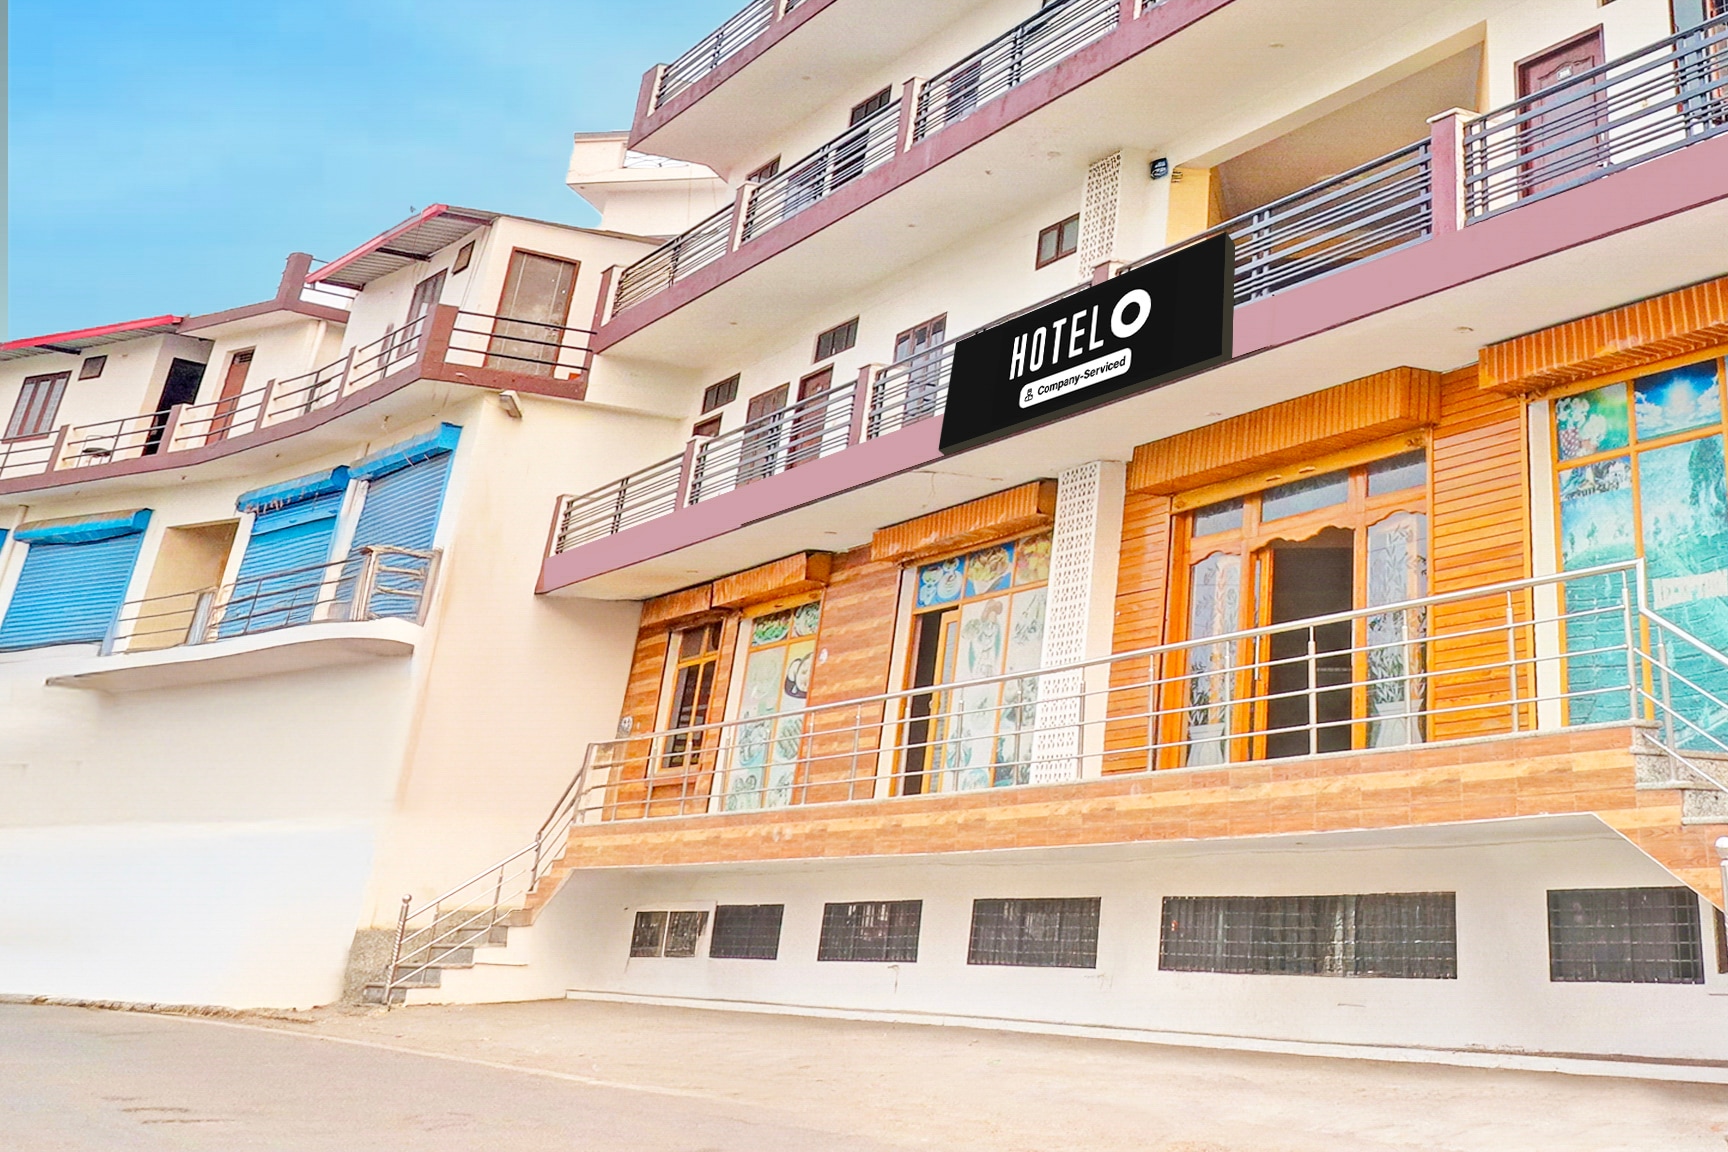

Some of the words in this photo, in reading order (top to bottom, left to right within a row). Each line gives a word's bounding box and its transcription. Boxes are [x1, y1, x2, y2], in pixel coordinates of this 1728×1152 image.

[1009, 304, 1104, 380] HOTEL
[1110, 288, 1152, 338] O
[1037, 356, 1126, 396] Company-Serviced
